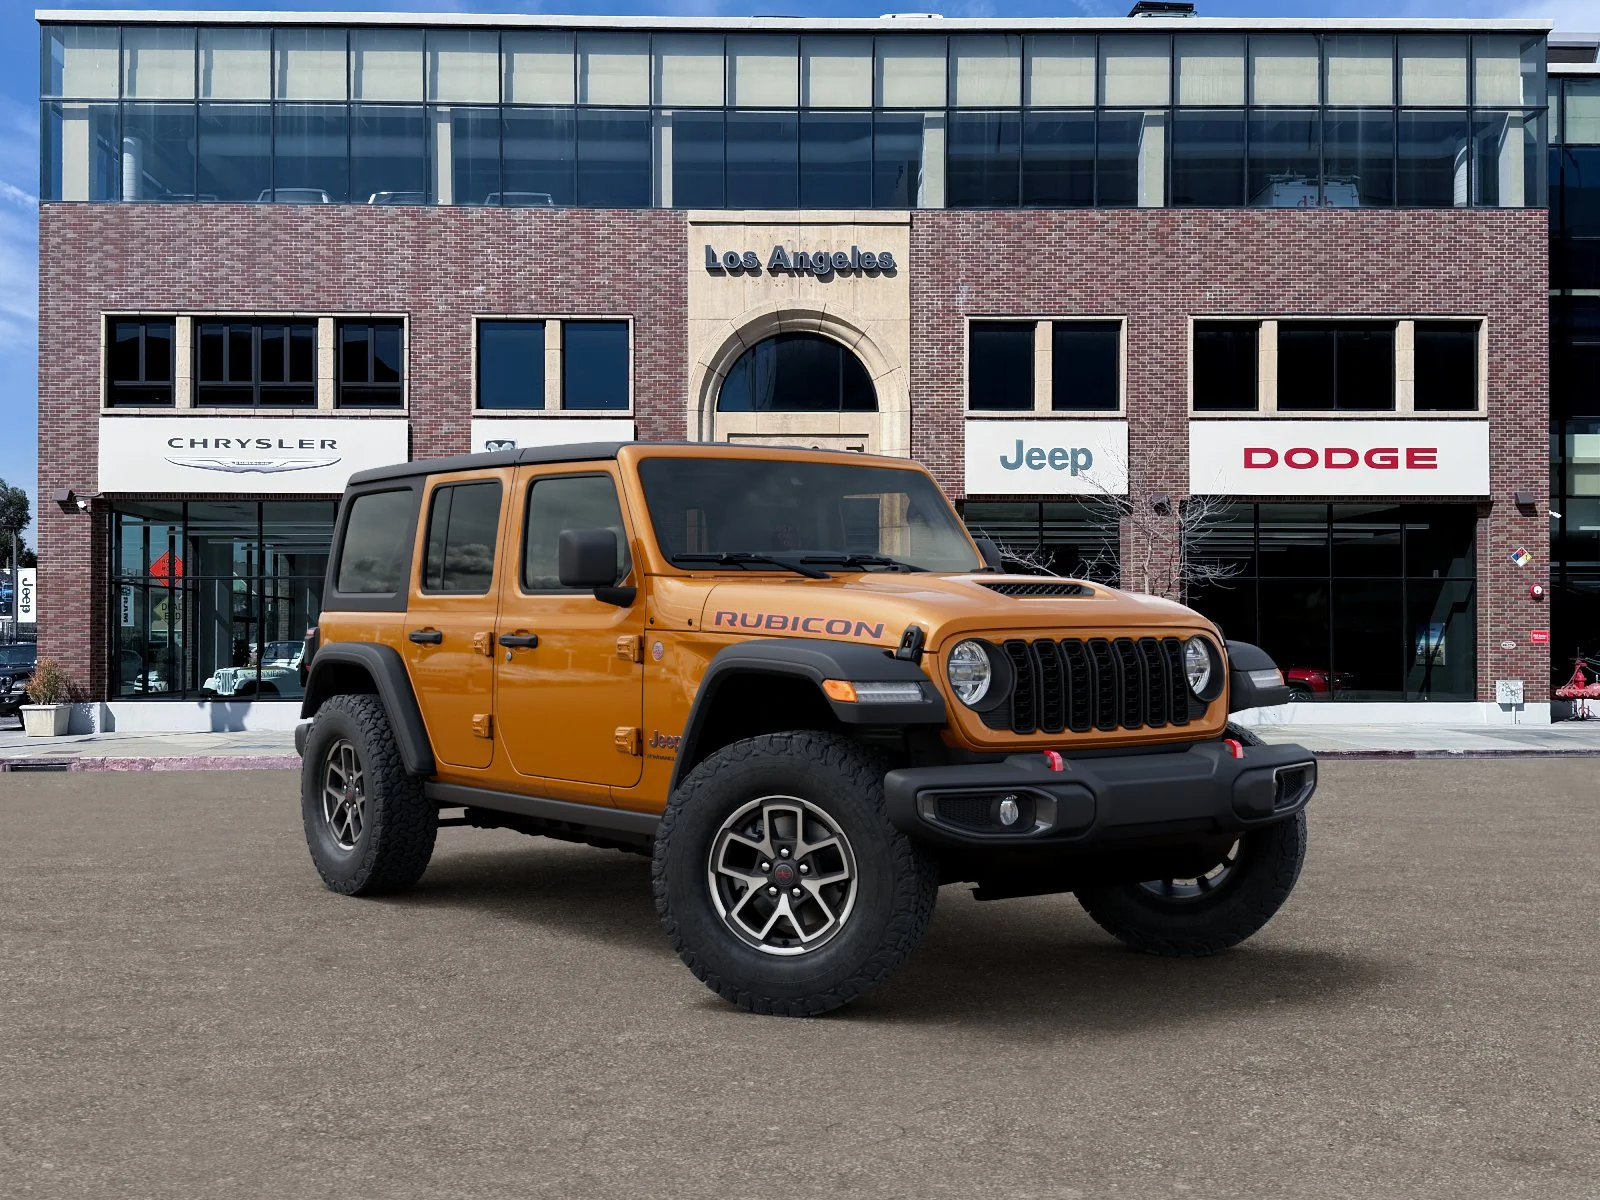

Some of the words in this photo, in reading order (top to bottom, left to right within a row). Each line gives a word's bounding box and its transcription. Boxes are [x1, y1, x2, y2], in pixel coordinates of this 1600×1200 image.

[705, 245, 757, 268] Los
[767, 245, 894, 274] Angeles
[168, 437, 338, 449] CHRYSLER
[1000, 439, 1093, 476] Jeep
[1244, 448, 1437, 469] DODGE
[20, 578, 33, 613] Jeep
[714, 611, 885, 638] RUBICON
[649, 729, 682, 753] Jeep
